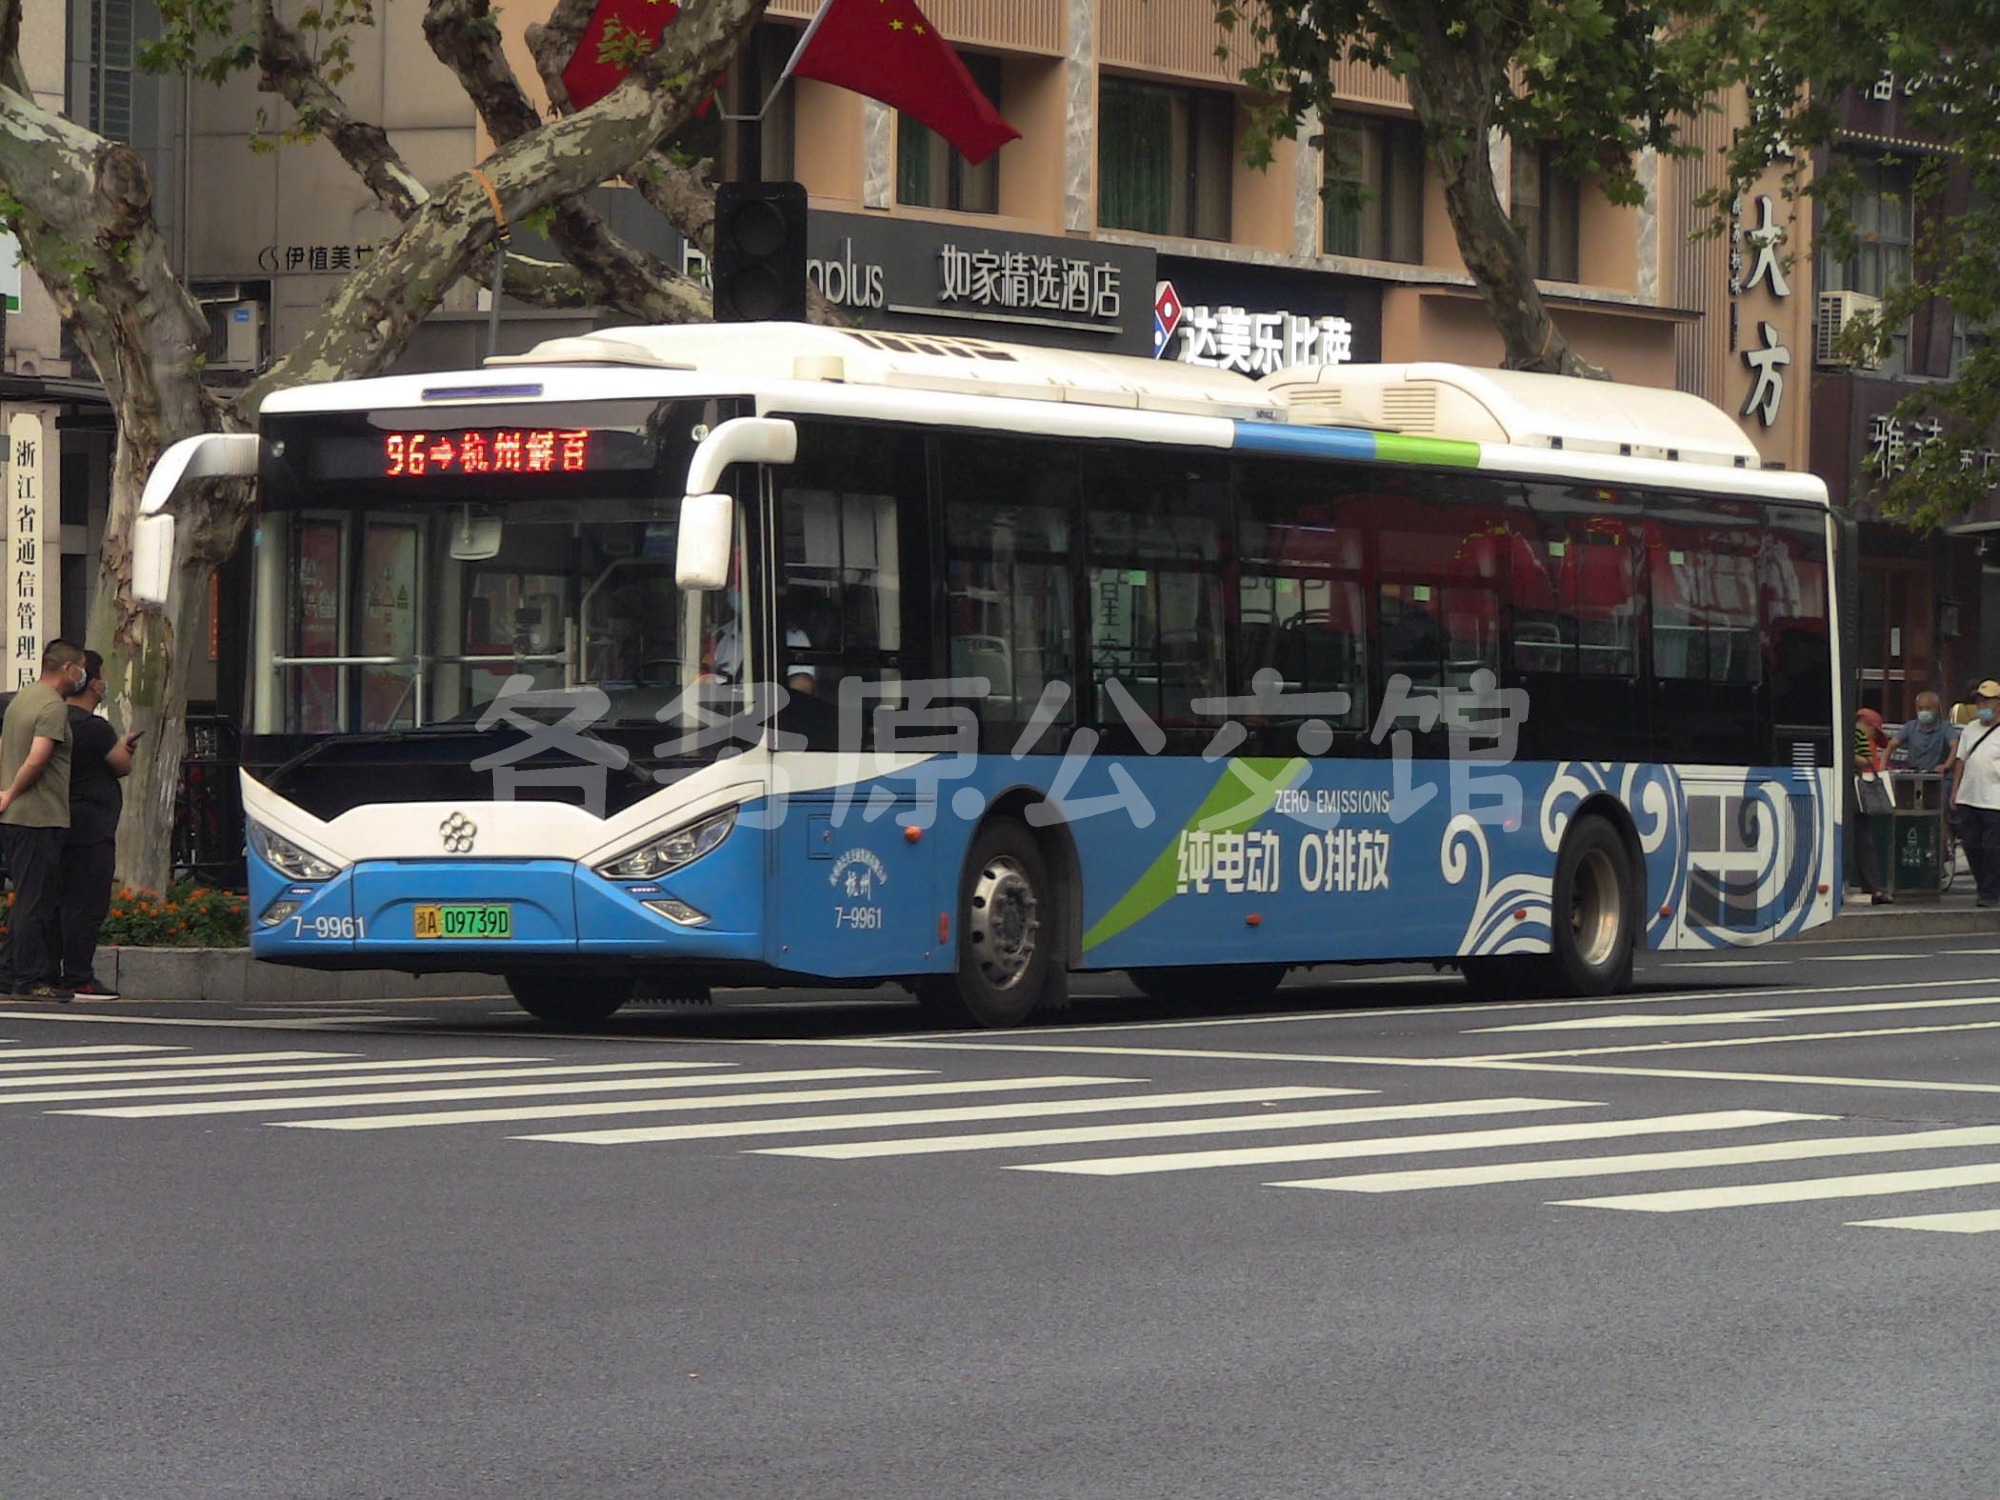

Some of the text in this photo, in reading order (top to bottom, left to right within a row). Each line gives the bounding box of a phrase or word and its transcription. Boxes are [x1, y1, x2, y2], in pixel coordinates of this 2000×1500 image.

[286, 245, 384, 271] 伊植美
[942, 244, 1121, 317] 如家精选酒店
[1180, 306, 1352, 374] 达美乐比萨
[387, 434, 425, 476] 96
[16, 440, 36, 692] 浙江省通信管理局
[1275, 790, 1389, 814] ZERO EMISSIONS
[1176, 830, 1280, 894] 纯电动
[292, 916, 365, 938] 7-9961
[835, 907, 881, 928] 7-9961
